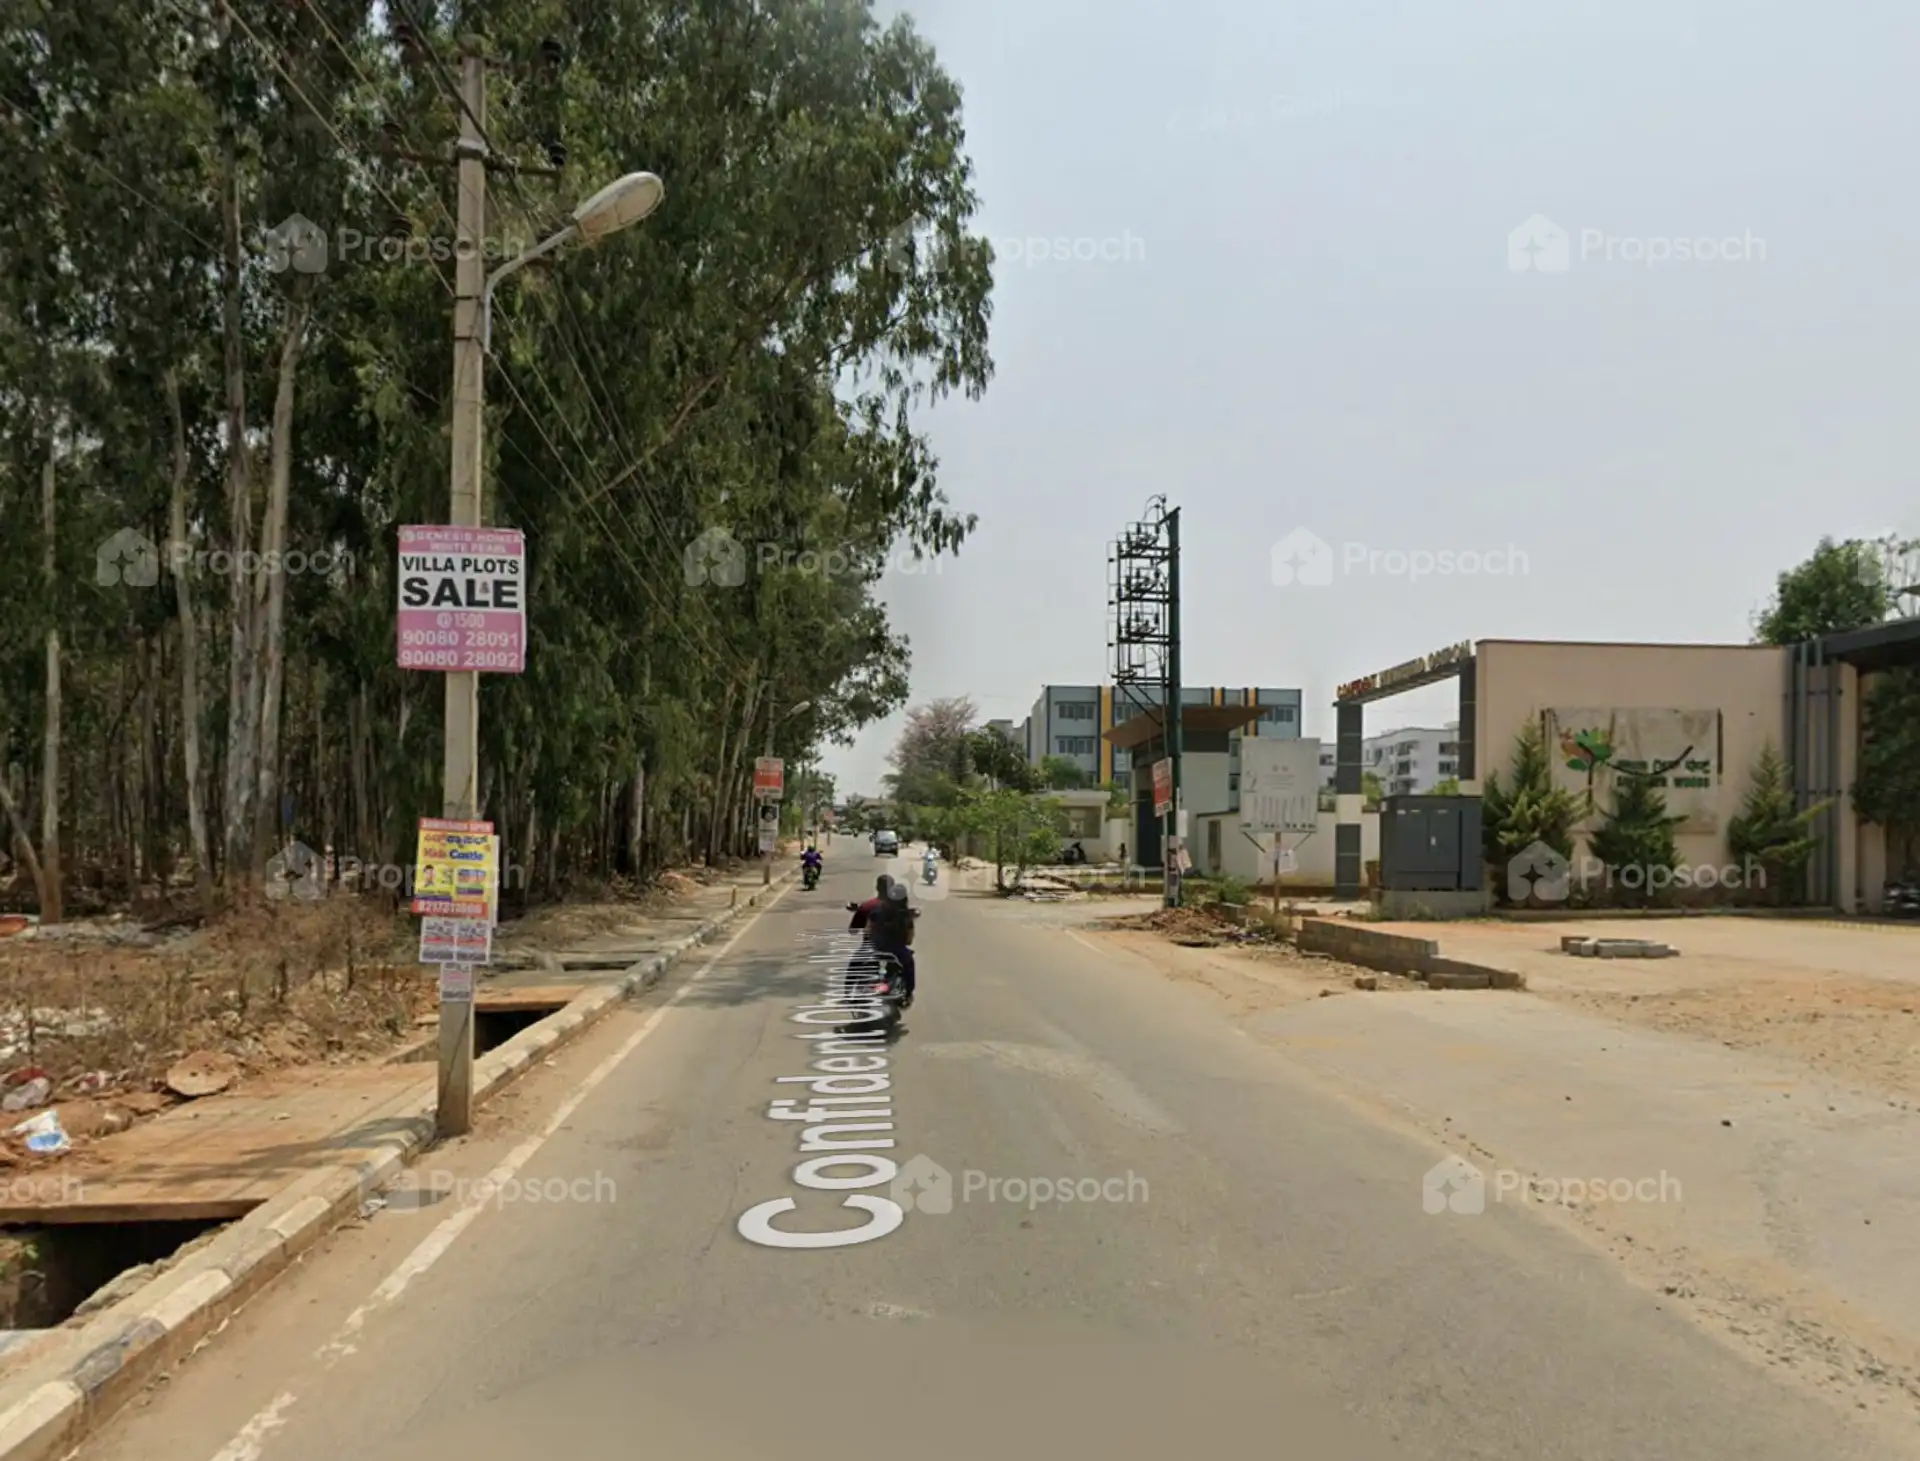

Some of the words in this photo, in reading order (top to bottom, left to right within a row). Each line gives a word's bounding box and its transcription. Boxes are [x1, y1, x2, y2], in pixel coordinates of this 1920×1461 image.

[402, 556, 455, 572] VILLA
[461, 558, 519, 574] PLOTS
[402, 577, 518, 609] SALE
[402, 631, 459, 646] 90080
[465, 631, 518, 647] 28091
[401, 651, 458, 666] 90080
[464, 651, 518, 667] 28092
